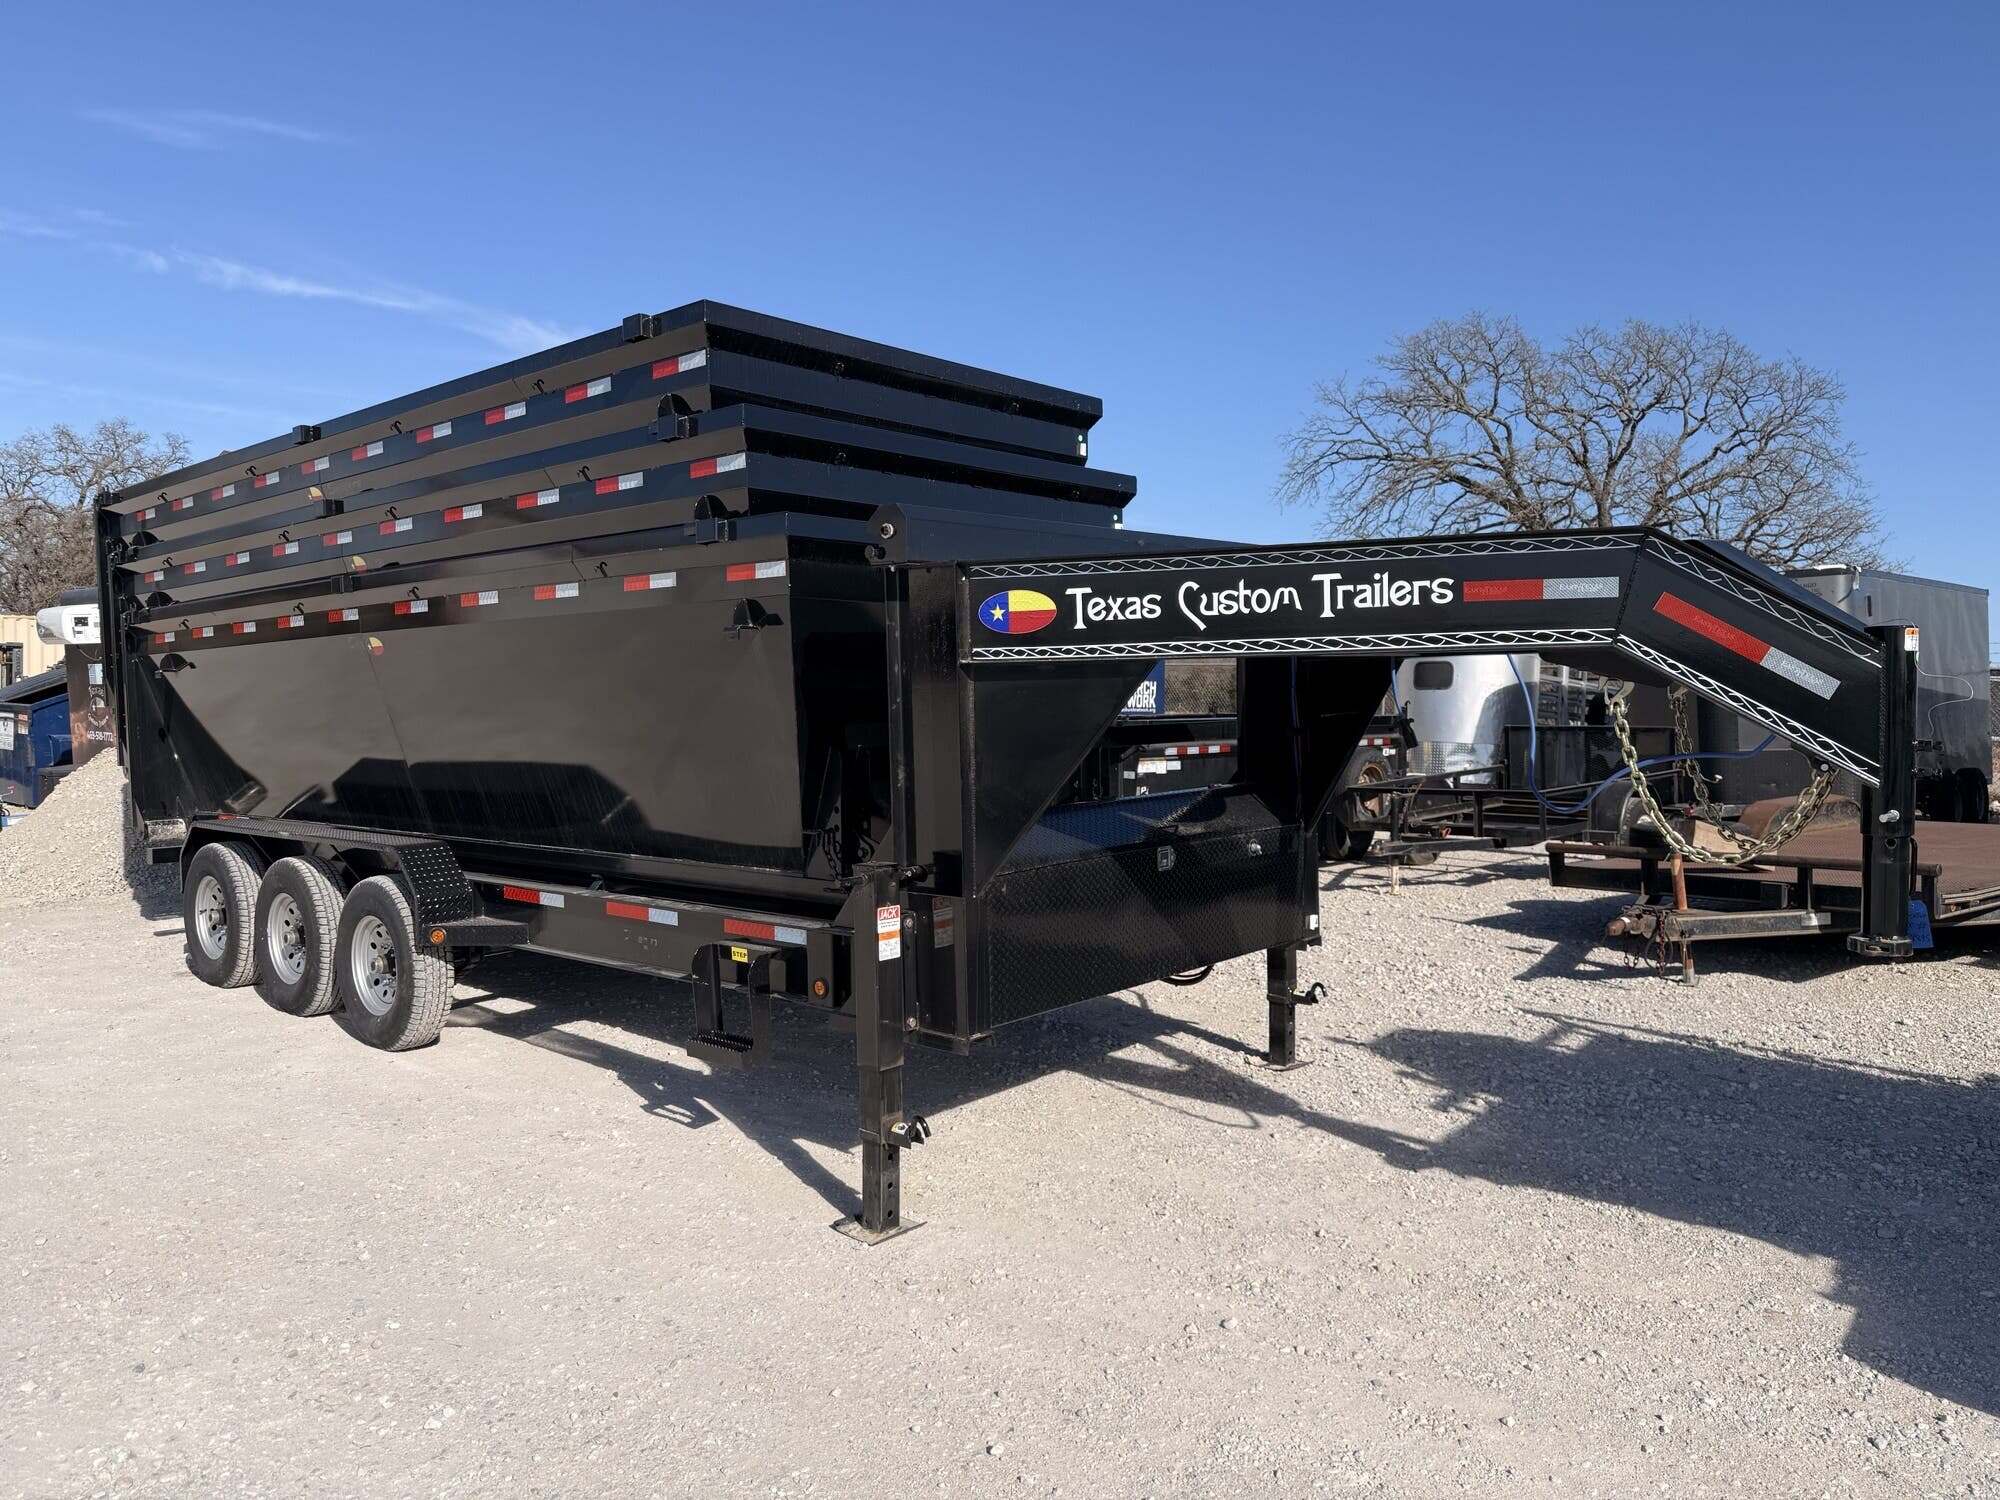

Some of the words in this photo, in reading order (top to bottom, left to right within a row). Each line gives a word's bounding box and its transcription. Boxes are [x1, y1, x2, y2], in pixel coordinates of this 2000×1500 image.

[1064, 586, 1162, 630] Texas
[1177, 580, 1303, 631] Custom
[1310, 571, 1455, 618] Trailers
[1133, 681, 1157, 694] RCH
[879, 907, 899, 920] JACK
[732, 950, 747, 959] STEP
